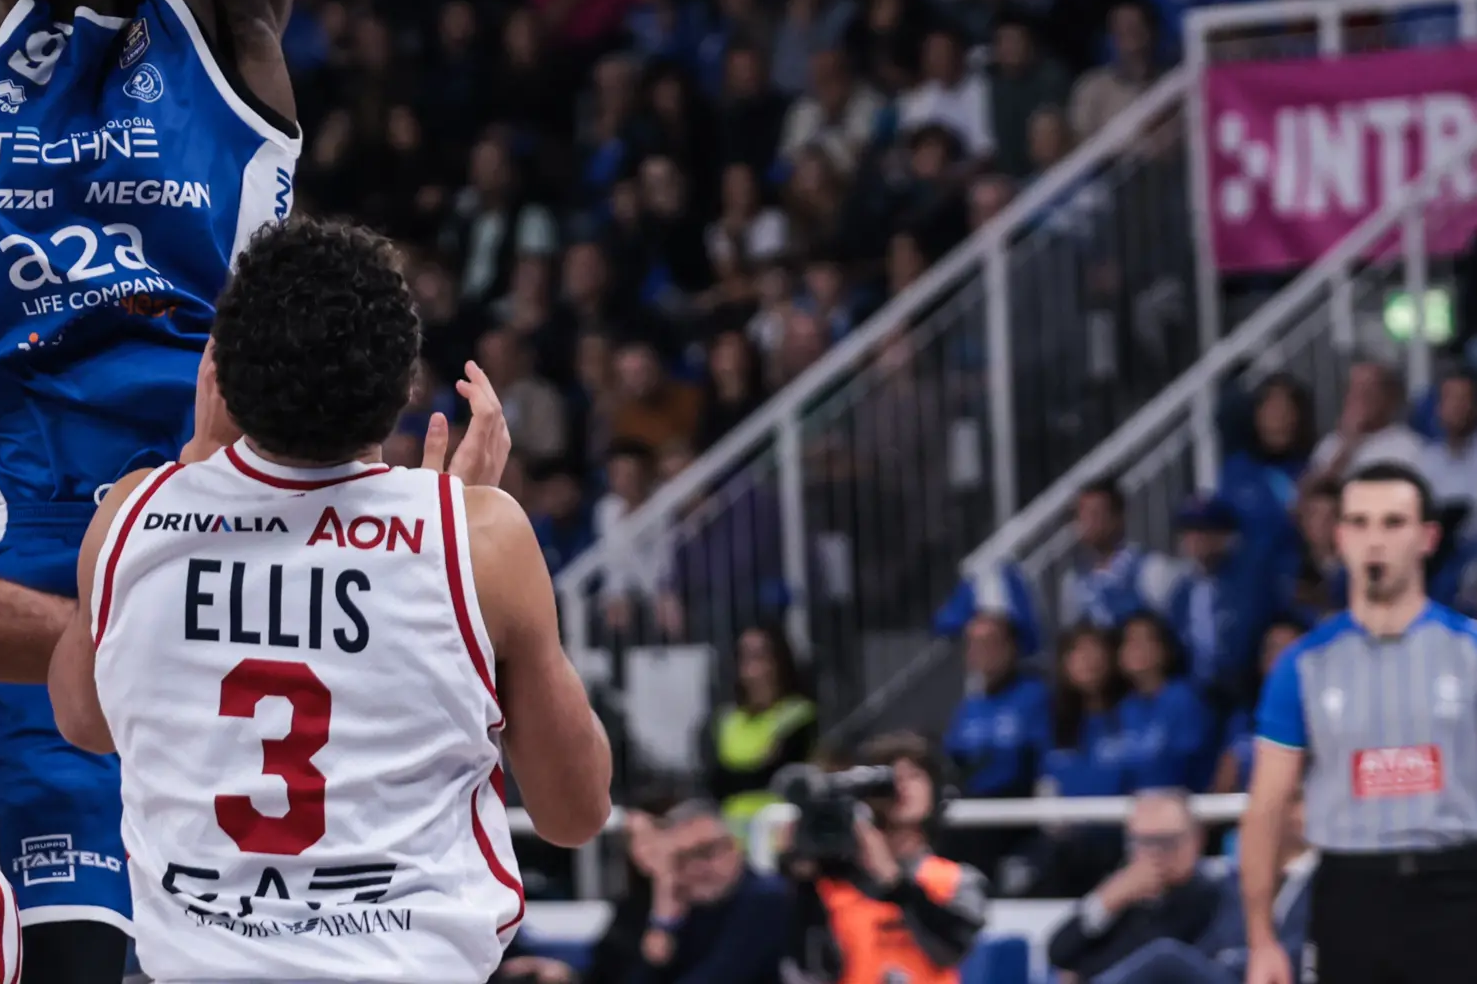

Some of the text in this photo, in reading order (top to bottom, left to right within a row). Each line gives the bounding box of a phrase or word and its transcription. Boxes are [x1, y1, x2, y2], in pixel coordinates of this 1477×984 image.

[21, 294, 64, 316] LIFE
[143, 506, 425, 554] DRIVALIA AON
[184, 558, 371, 654] ELLIS
[214, 658, 332, 856] 3
[318, 908, 412, 937] ARMANI
